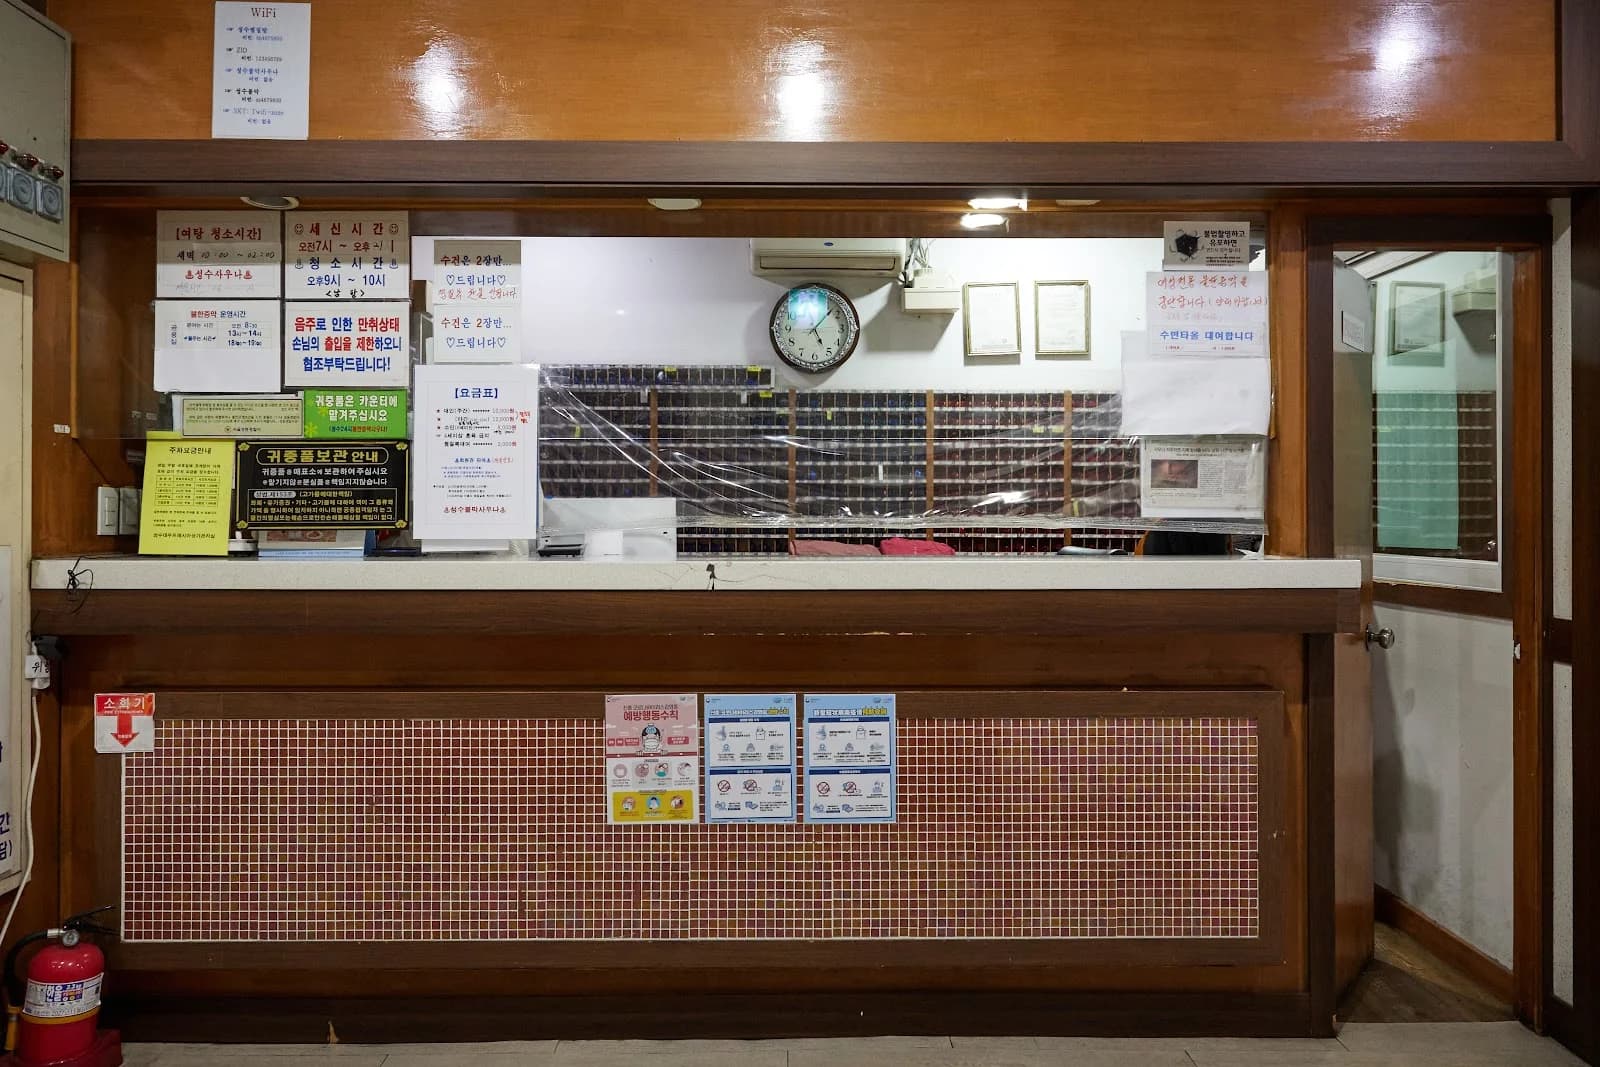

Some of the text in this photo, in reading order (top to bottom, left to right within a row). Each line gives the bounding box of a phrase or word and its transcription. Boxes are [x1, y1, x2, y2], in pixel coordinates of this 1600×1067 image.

[251, 7, 276, 18] WiFi
[176, 227, 261, 240] [여탕 청소시간]
[1203, 229, 1245, 239] 불법촬영하고
[298, 240, 332, 253] 오전7시
[1209, 238, 1237, 247] 유포하면
[177, 250, 195, 261] 새벽
[195, 269, 243, 280] 성수사우나
[307, 274, 341, 287] 오후9시
[362, 274, 386, 287] 10시
[294, 316, 400, 332] 음주로 인한 만취상태
[1204, 330, 1254, 341] 대여합니다
[292, 336, 402, 351] 손님의 출입을 제한하오니
[303, 356, 391, 372] 협조부탁드립니다!
[315, 395, 398, 407] 귀중품은 카운터에
[169, 446, 212, 455] 주차요금안내
[104, 697, 145, 709] 소화기
[623, 710, 679, 721] 예방행동수칙
